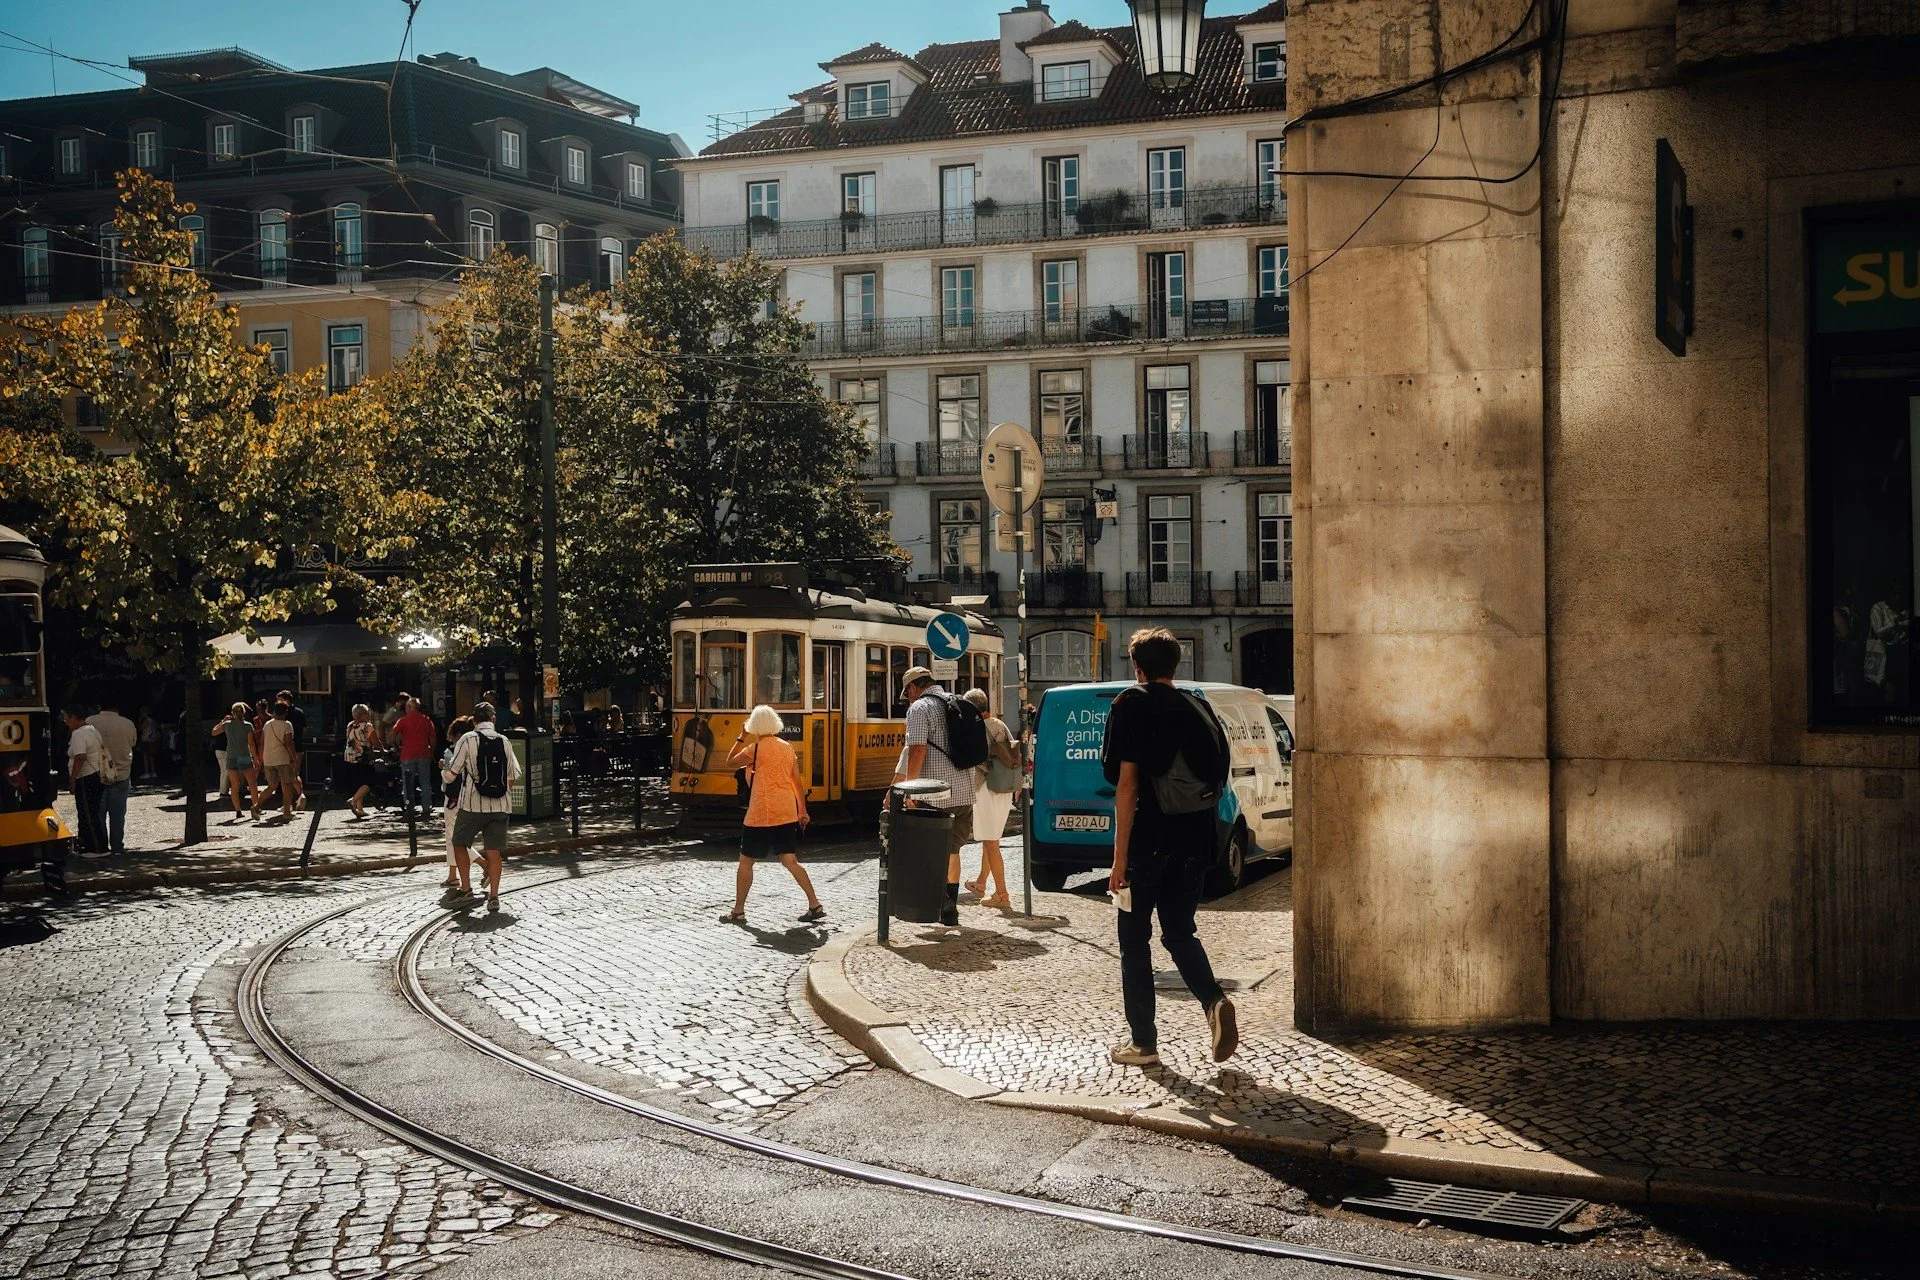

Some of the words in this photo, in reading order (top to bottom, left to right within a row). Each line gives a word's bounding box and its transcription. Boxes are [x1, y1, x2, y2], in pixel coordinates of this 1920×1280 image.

[1832, 250, 1920, 308] SU
[693, 571, 737, 583] CARREIRA
[715, 619, 728, 627] 564
[1066, 710, 1077, 724] A
[858, 734, 863, 748] O
[864, 734, 885, 748] LICOR
[886, 734, 895, 747] DE
